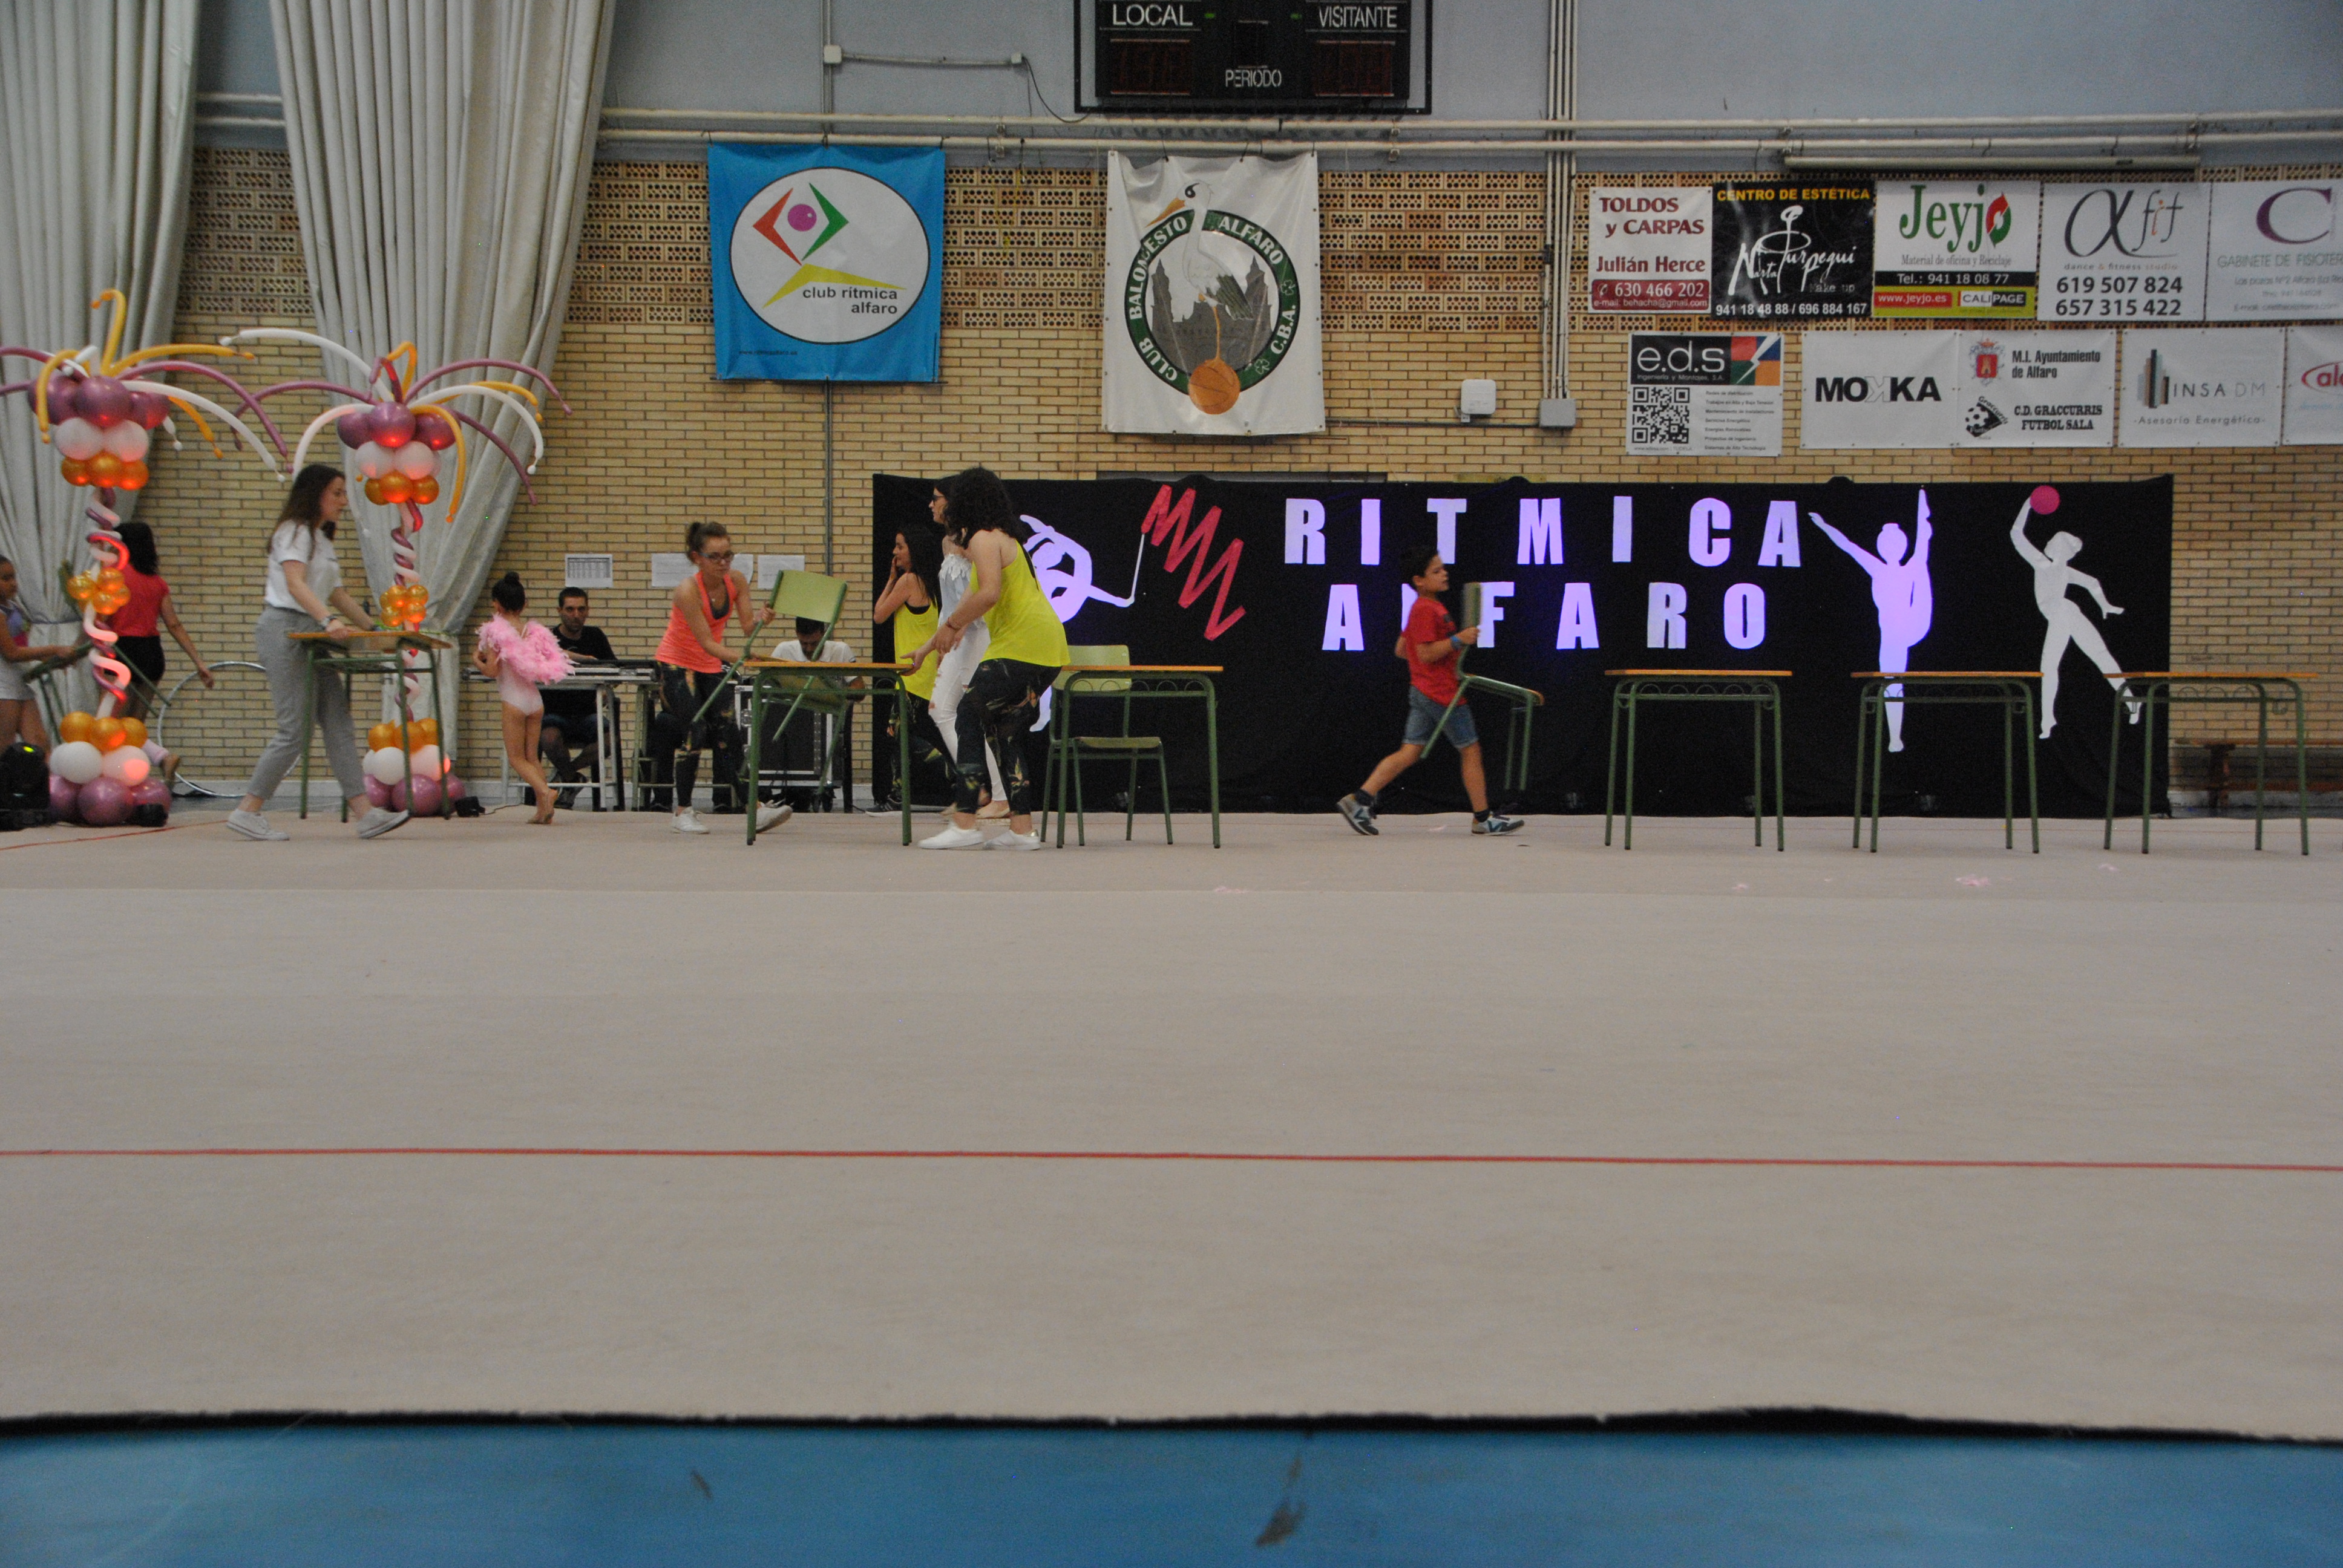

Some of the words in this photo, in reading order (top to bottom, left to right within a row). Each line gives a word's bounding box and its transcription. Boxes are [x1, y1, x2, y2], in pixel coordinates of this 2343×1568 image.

[1112, 4, 1193, 27] LOCAL
[1319, 6, 1398, 28] VISITANTE
[1225, 68, 1282, 88] PERIODO
[1717, 189, 1775, 201] CENTRO
[1779, 189, 1797, 201] DE
[1802, 187, 1870, 200] ESTÉTICA
[1599, 197, 1679, 213] TOLDOS
[1605, 221, 1617, 238] y
[1623, 218, 1705, 235] CARPAS
[1596, 256, 1648, 273] Julián
[1655, 256, 1706, 273] Herce
[1901, 254, 1933, 265] Material
[1935, 254, 1944, 265] de
[1946, 254, 1970, 265] oficina
[1973, 257, 1978, 267] y
[2217, 253, 2271, 268] GABINETE
[2275, 253, 2291, 267] DE
[1928, 273, 1950, 284] 941
[1956, 273, 1970, 284] 18
[1974, 273, 1990, 284] 08
[1994, 273, 2010, 284] 77
[2056, 276, 2095, 294] 619
[2100, 276, 2138, 294] 507
[2144, 276, 2183, 294] 824
[802, 286, 836, 298] club
[842, 286, 897, 299] rítmica
[1614, 283, 1641, 297] 630
[1646, 283, 1673, 297] 466
[1678, 283, 1704, 297] 202
[1139, 336, 1178, 382] CLUB
[1218, 215, 1284, 265] ALFARO
[1878, 293, 1947, 304] www.jeyjo.es
[851, 301, 897, 314] alfaro
[1716, 304, 1736, 316] 941
[1740, 304, 1754, 316] 18
[1757, 304, 1772, 315] 48
[1775, 304, 1790, 315] 88
[1798, 304, 1820, 315] 696
[1823, 304, 1843, 315] 884
[1847, 303, 1868, 315] 167
[2056, 299, 2094, 316] 657
[2099, 299, 2137, 316] 315
[2143, 299, 2181, 316] 422
[2035, 349, 2101, 365] Ayuntamiento
[2012, 365, 2024, 379] de
[2027, 365, 2057, 379] Alfaro
[2174, 383, 2226, 397] INSA
[2014, 405, 2032, 416] C.D.
[2034, 404, 2103, 416] GRACCURRIS
[2021, 419, 2065, 430] FUTBOL
[2066, 419, 2094, 430] SALA
[1284, 495, 1801, 567] RITMICA
